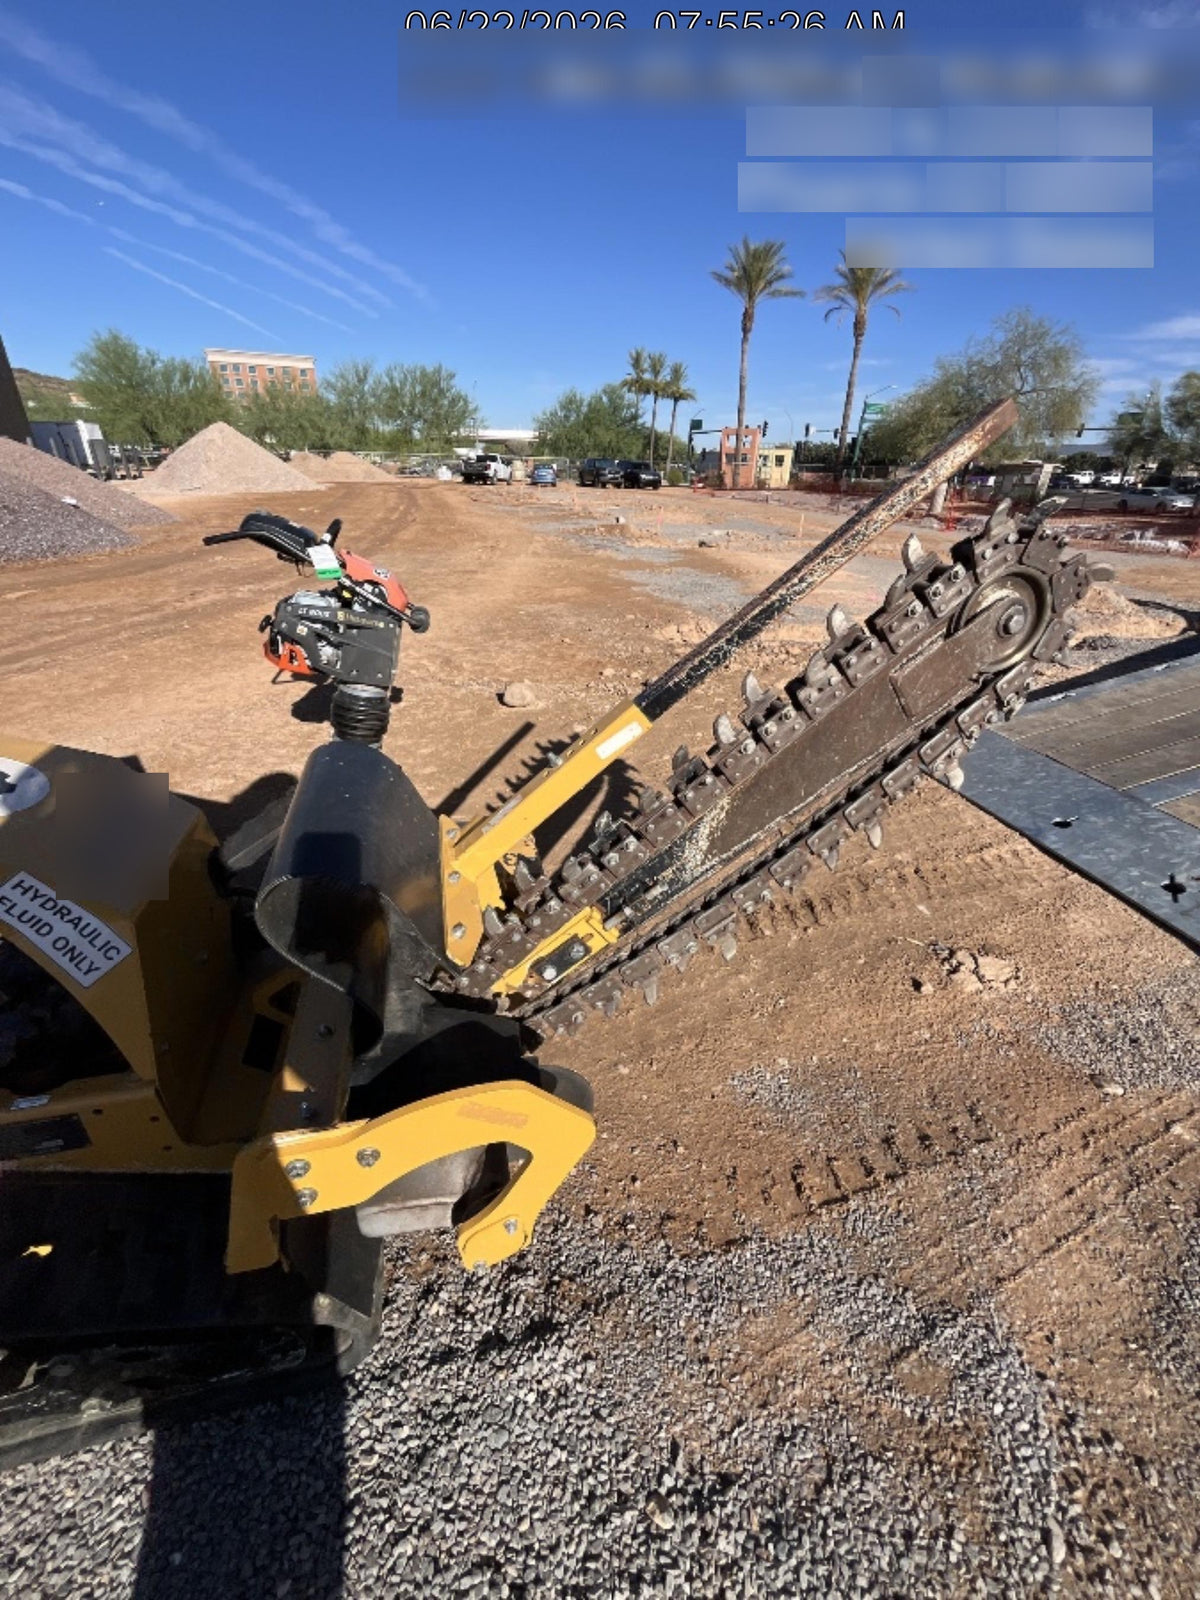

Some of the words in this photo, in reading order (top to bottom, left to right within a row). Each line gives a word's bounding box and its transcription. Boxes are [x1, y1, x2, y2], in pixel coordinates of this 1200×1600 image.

[0, 895, 54, 937] FLUID
[51, 936, 101, 976] ONLY
[10, 879, 121, 961] HYDRAULIC
